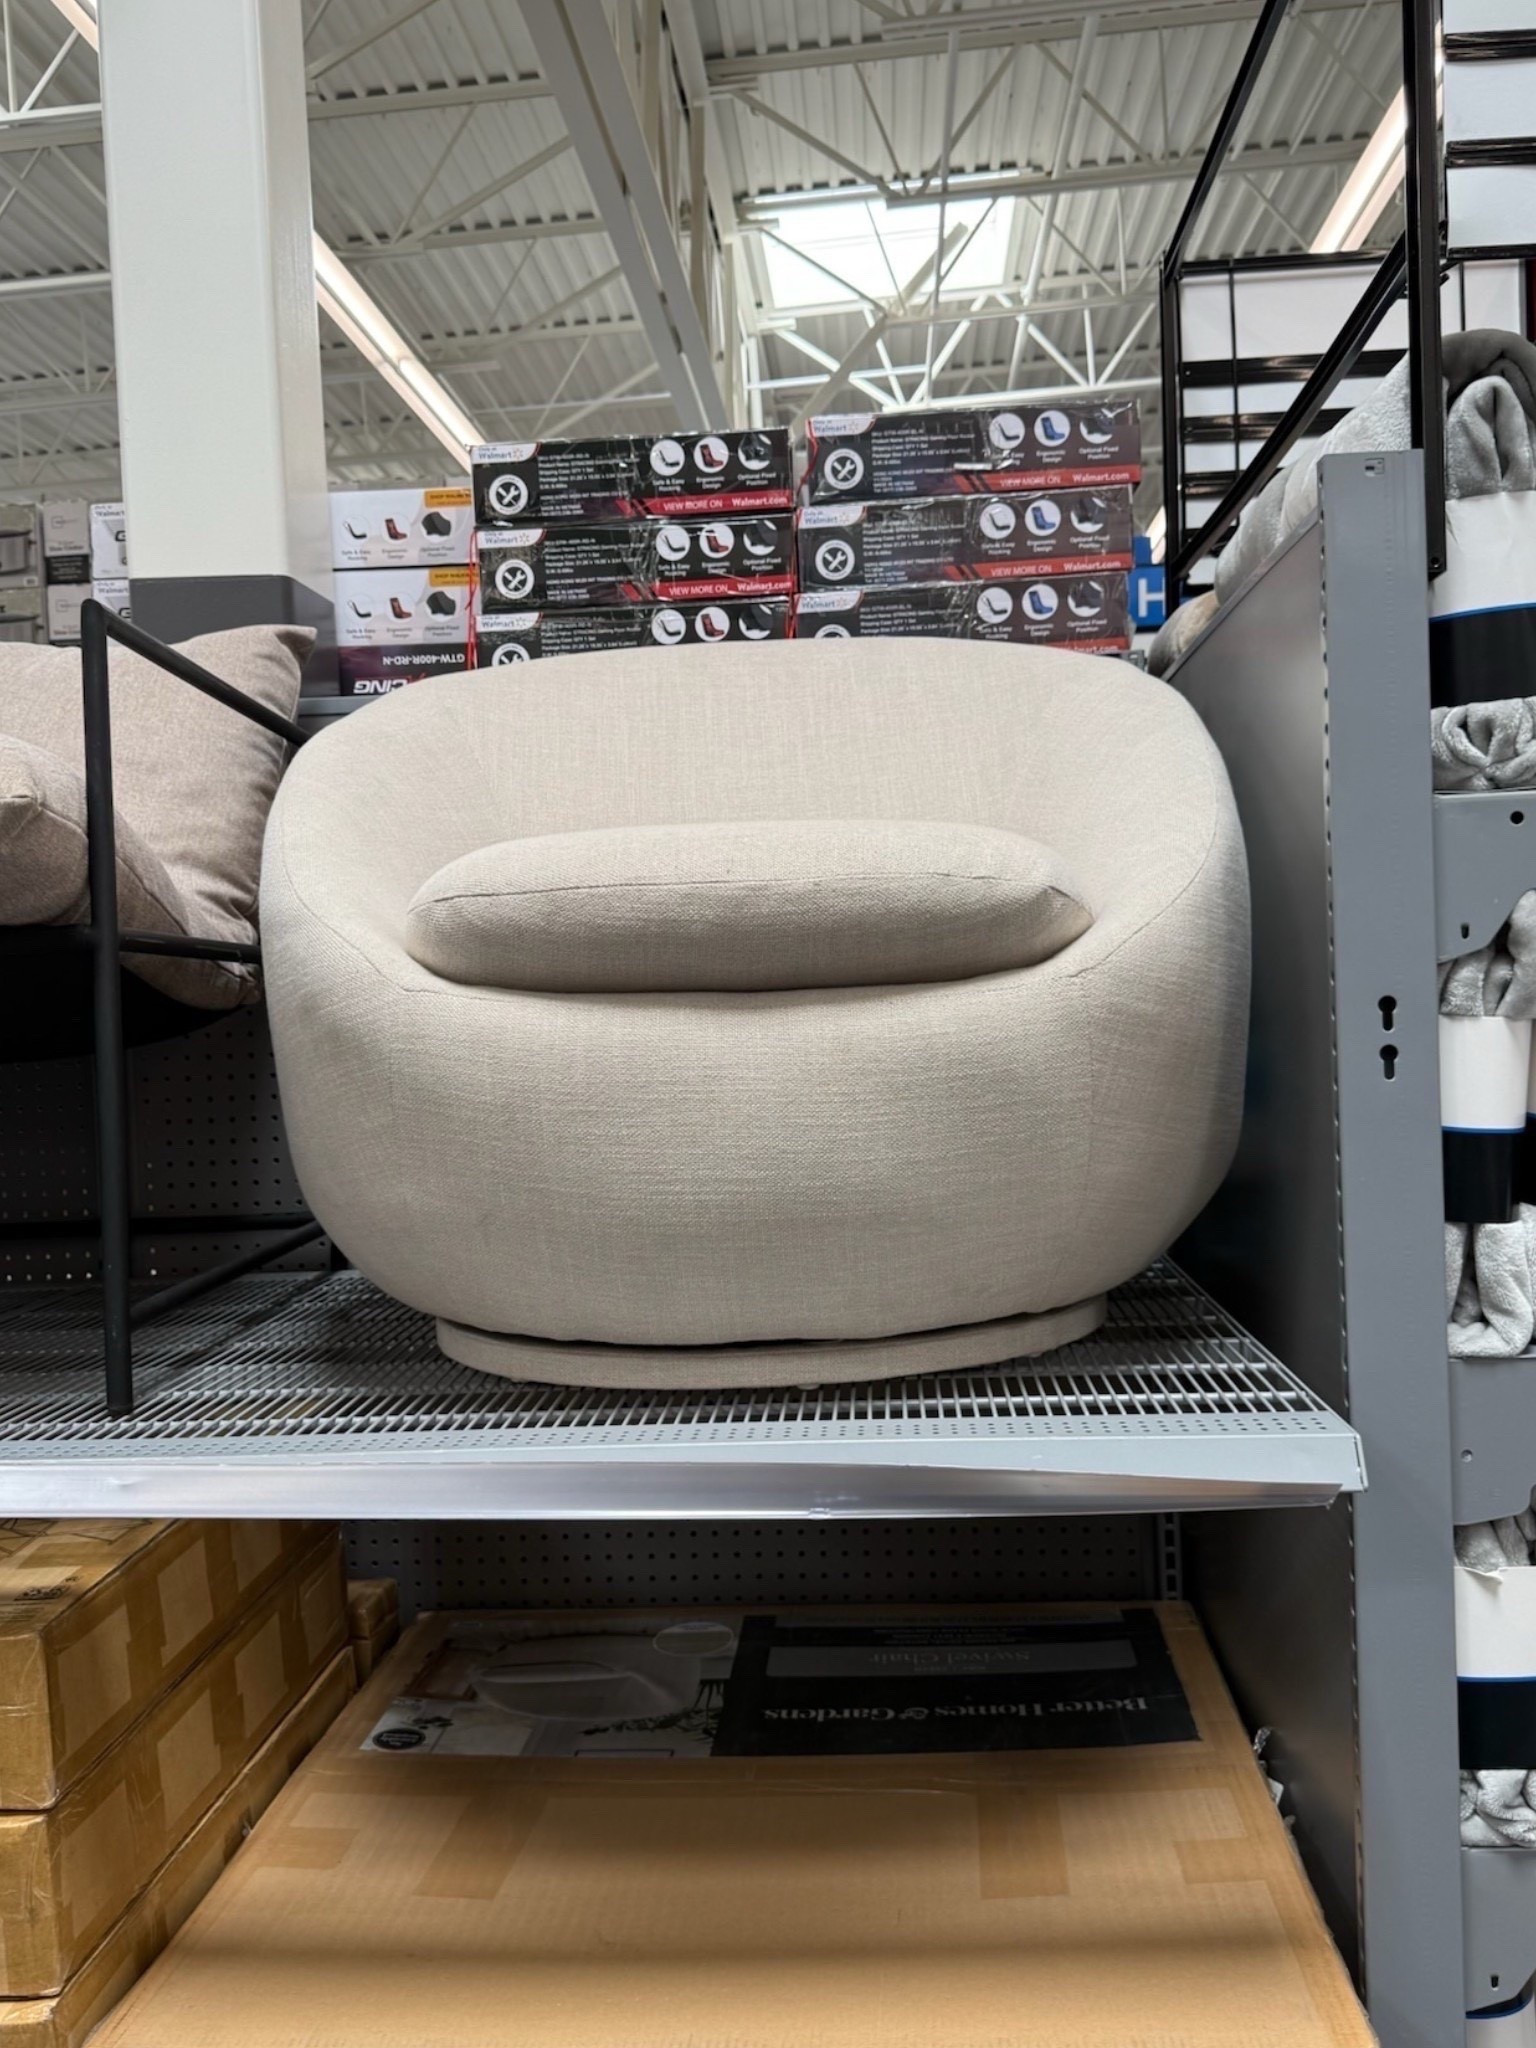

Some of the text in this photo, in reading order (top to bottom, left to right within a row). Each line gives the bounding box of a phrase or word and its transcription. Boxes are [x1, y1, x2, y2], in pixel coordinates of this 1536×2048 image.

[479, 451, 511, 459] Walmart
[1001, 472, 1129, 487] VIEW MORE ON Walmart.com
[664, 496, 788, 511] VIEW MORE ON Walmart.com
[804, 516, 837, 524] Walmart
[485, 536, 518, 544] Walmart
[991, 561, 1121, 576] VIEW MORE ON Walmart.com
[669, 581, 792, 596] VIEW MORE ON Walmart.com
[482, 619, 514, 628] Walmart
[383, 654, 465, 665] GTW-400R-RD-N
[869, 1650, 1031, 1663] Swivel Chair
[764, 1697, 1148, 1722] Better Homes & Gardens
